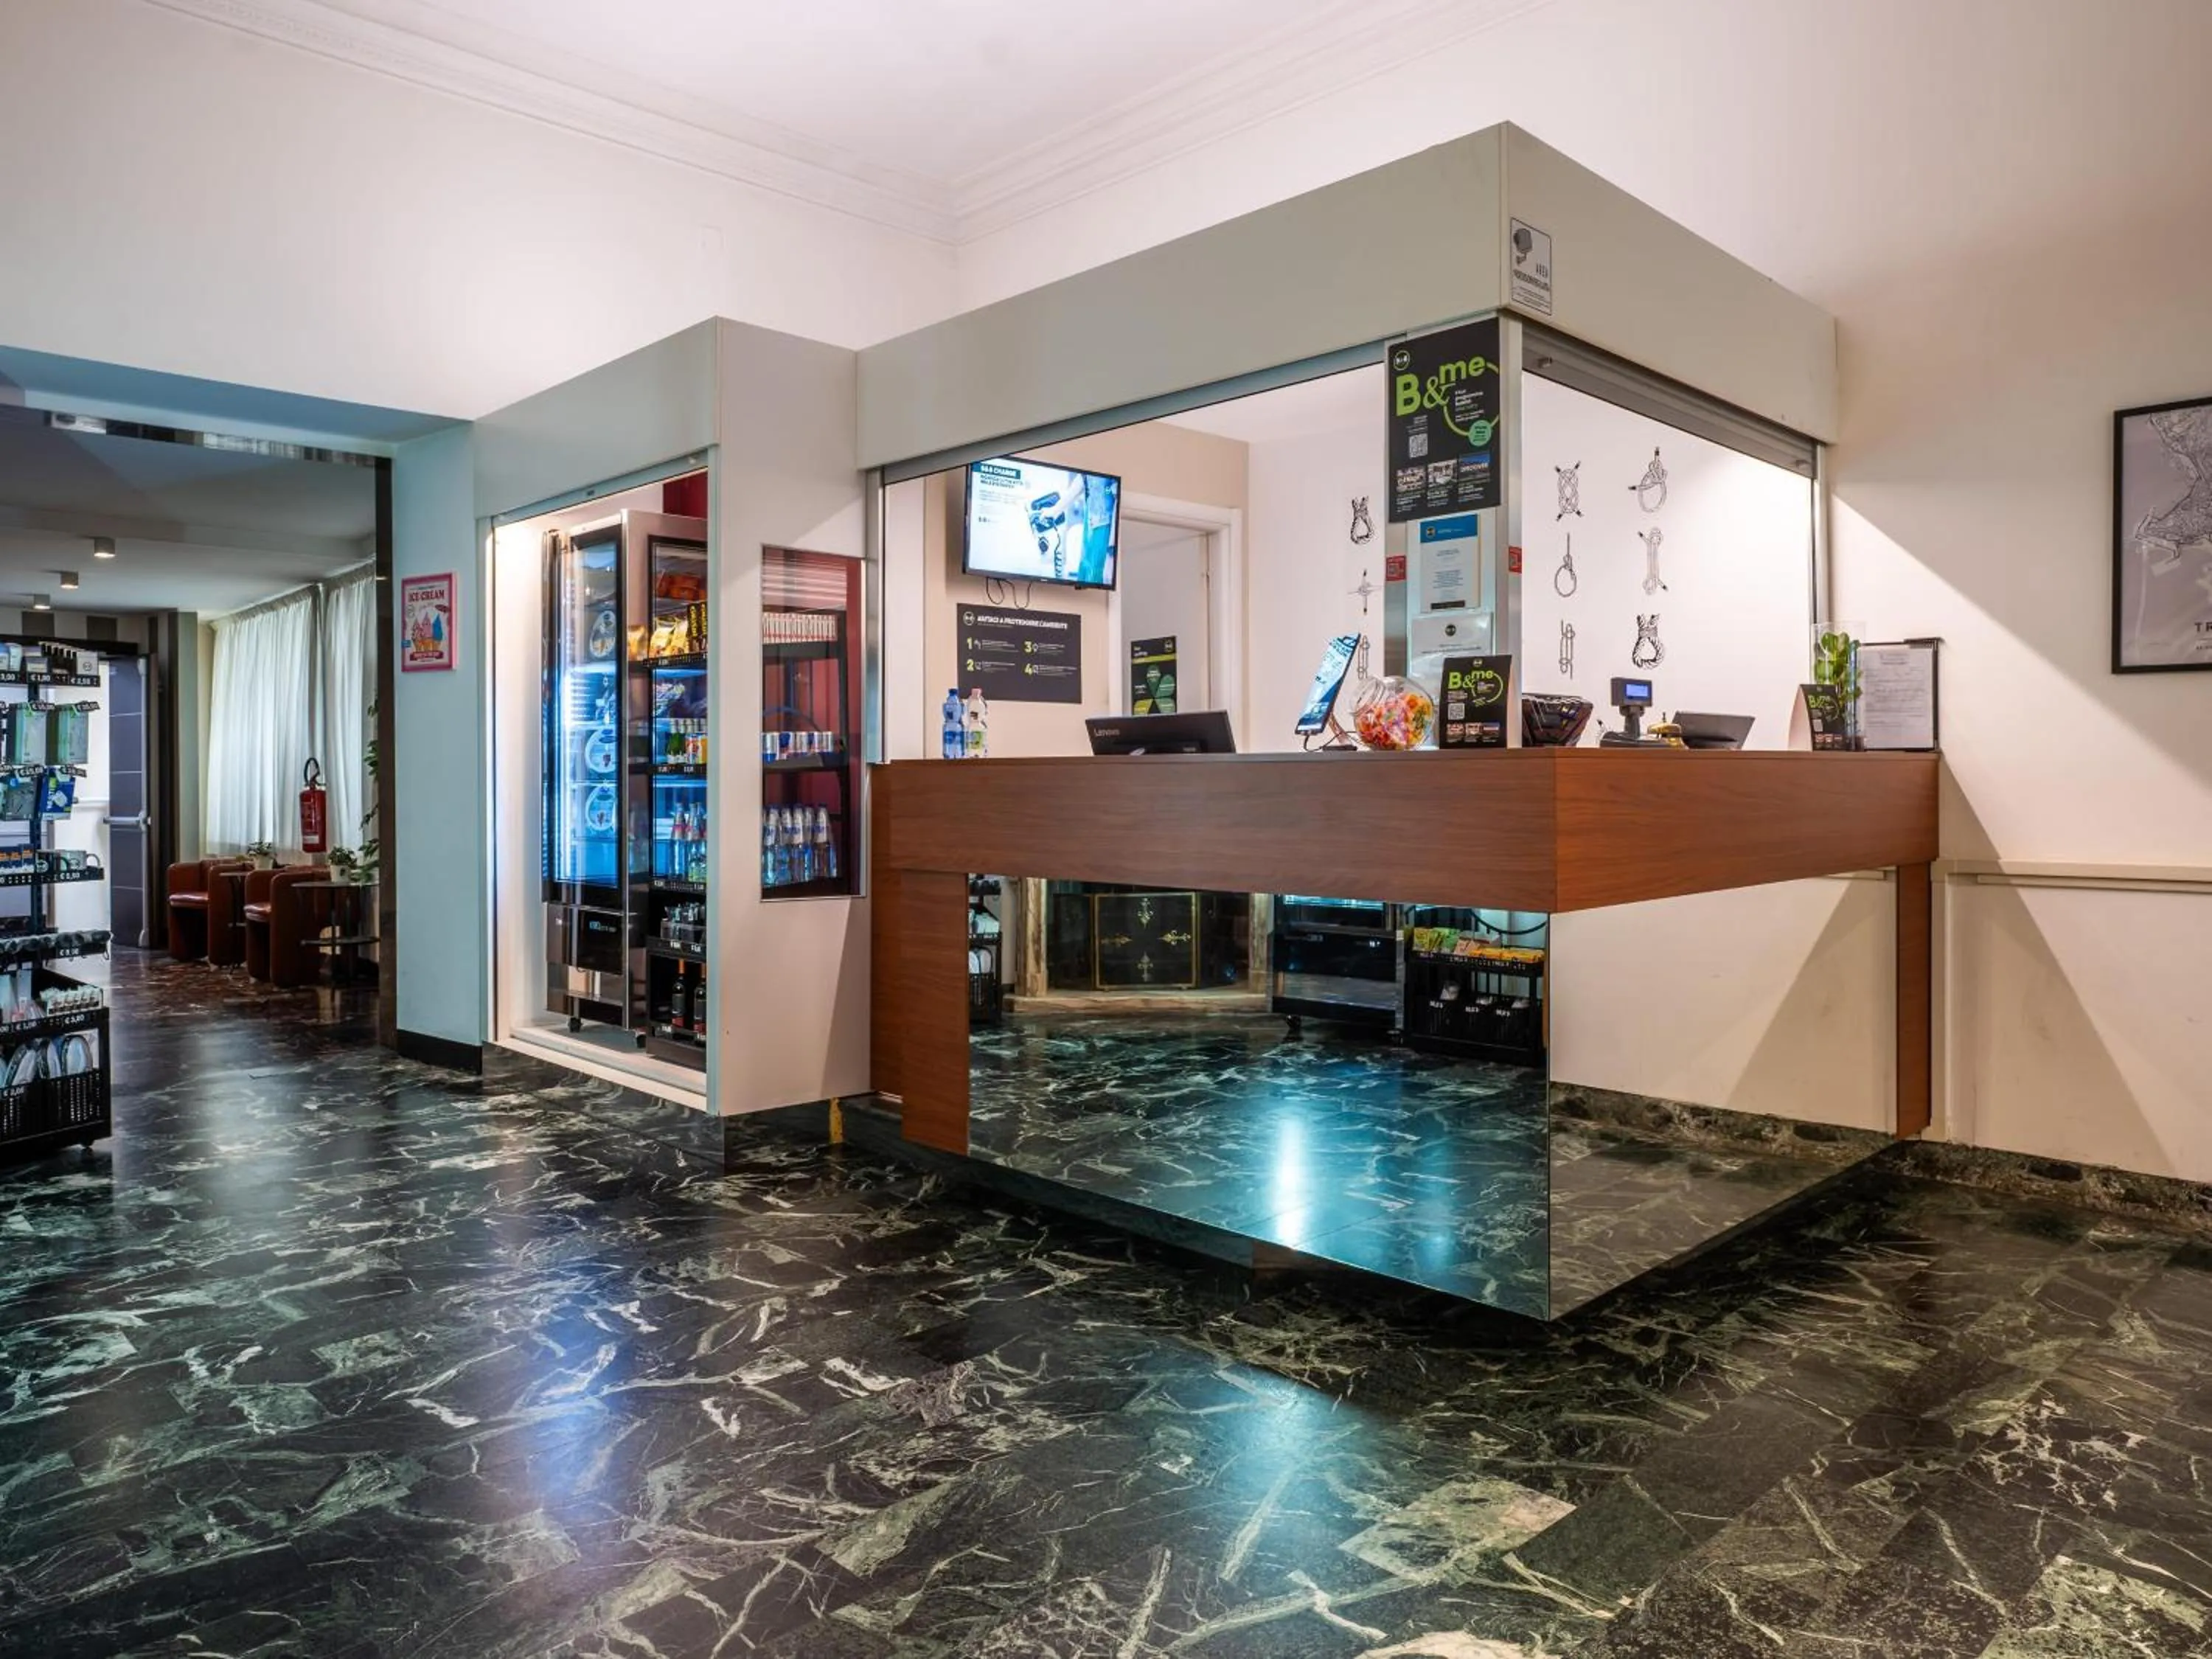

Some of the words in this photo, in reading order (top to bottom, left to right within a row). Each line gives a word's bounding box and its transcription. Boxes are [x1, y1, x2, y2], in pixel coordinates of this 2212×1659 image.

[1396, 356, 1486, 417] B&me
[967, 637, 973, 650] 1
[1024, 640, 1032, 653] 3
[967, 658, 975, 672] 2
[1024, 663, 1033, 675] 4
[1447, 669, 1494, 689] B&me
